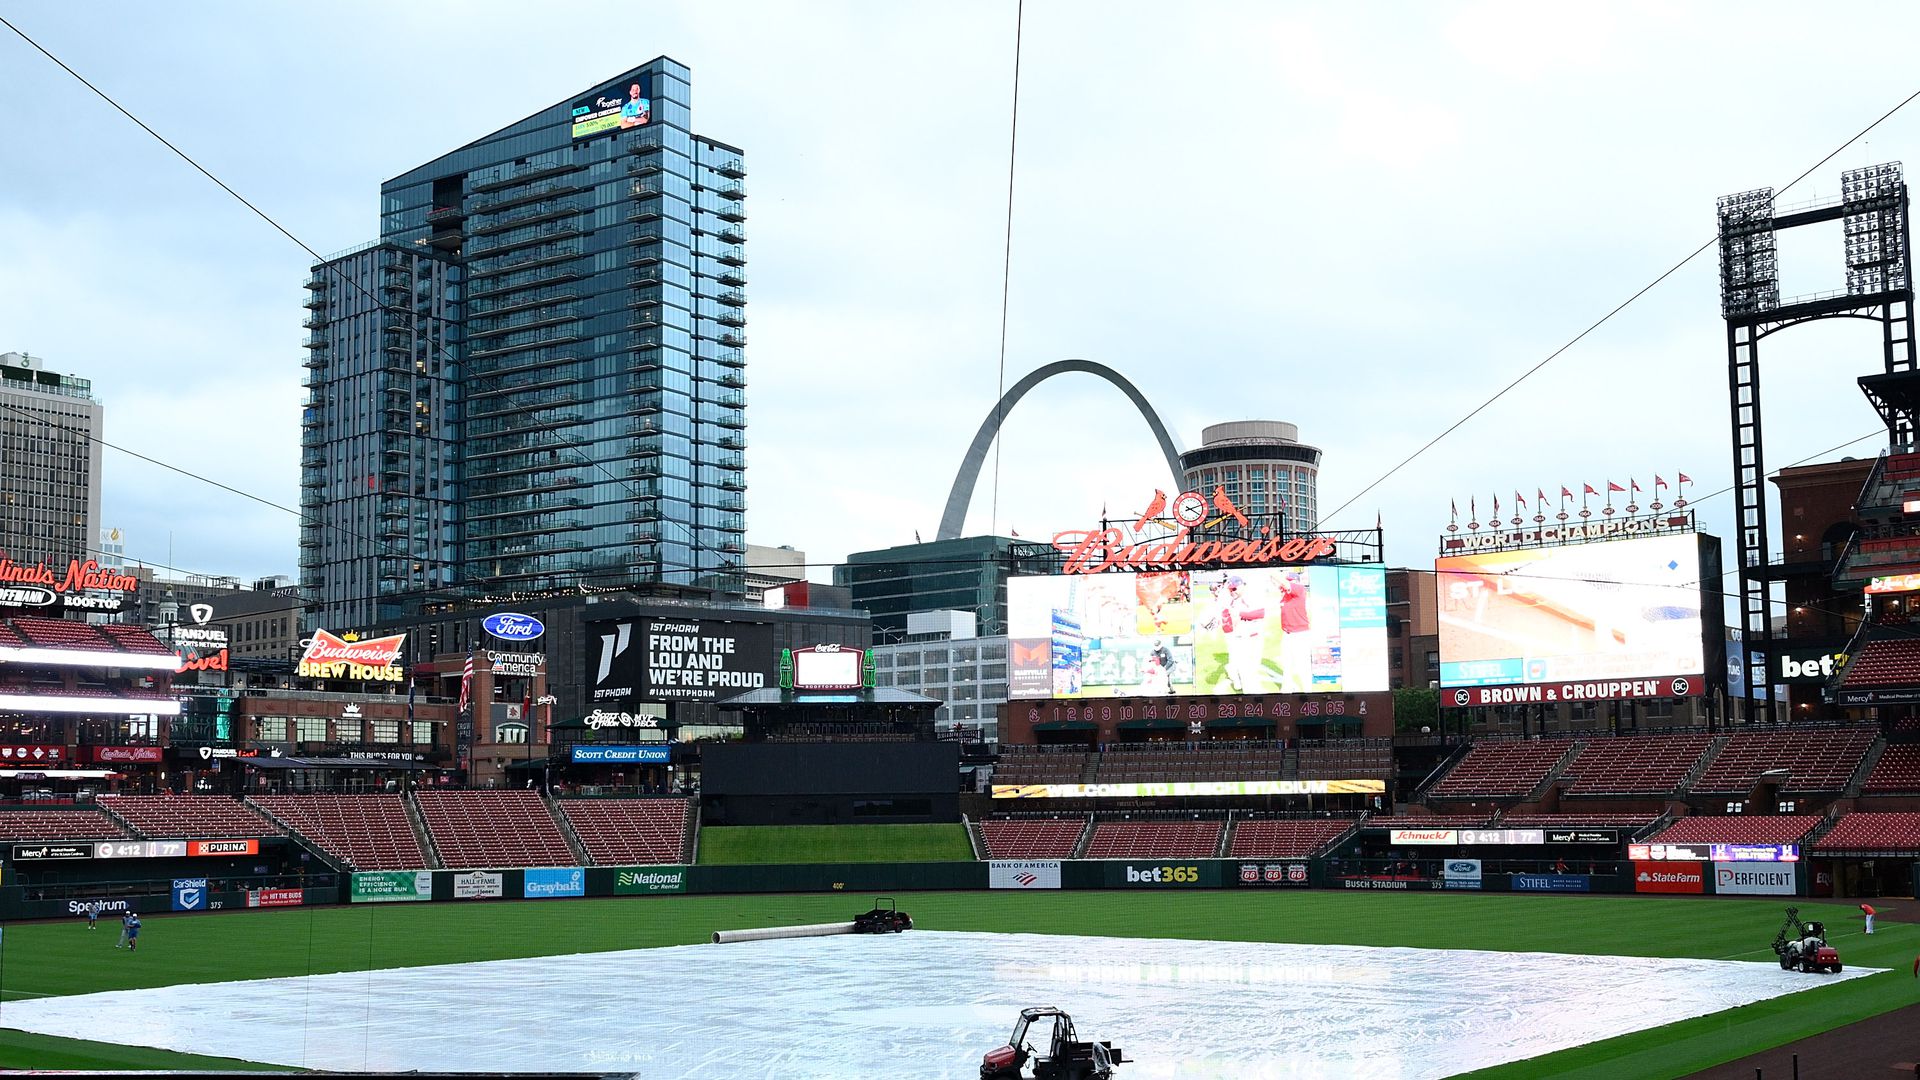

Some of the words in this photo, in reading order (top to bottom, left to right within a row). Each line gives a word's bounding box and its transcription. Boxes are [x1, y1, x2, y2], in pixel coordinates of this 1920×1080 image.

[601, 98, 622, 108] Together
[1463, 531, 1535, 549] WORLD
[1541, 517, 1669, 541] CHAMPIONS
[1053, 527, 1337, 574] Budweiser
[55, 560, 136, 592] Nation
[271, 589, 291, 598] HYATT
[64, 596, 121, 609] ROOFTOP
[496, 616, 533, 635] Ford
[175, 628, 228, 641] FANDUEL
[300, 639, 402, 661] Budweiser
[650, 635, 698, 652] FROM
[702, 638, 735, 653] THE
[488, 651, 544, 666] Community
[650, 652, 682, 668] LOU
[687, 654, 722, 670] AND
[492, 657, 536, 673] America
[299, 663, 346, 678] BREW
[350, 665, 403, 681] HOUSE
[649, 669, 704, 686] WE'RE
[708, 671, 764, 688] PROUD
[1481, 686, 1542, 704] BROWN
[1546, 689, 1557, 701] &
[1562, 680, 1658, 701] CROUPPEN
[1674, 682, 1686, 691] BC
[650, 689, 715, 697] #IAM1STPHORM
[1457, 693, 1467, 702] BC
[1847, 695, 1869, 703] Mercy
[1054, 708, 1059, 720] 1
[1067, 708, 1076, 721] 2
[1084, 707, 1093, 720] 6
[1102, 707, 1111, 720] 9
[1120, 706, 1133, 719] 10
[1143, 706, 1157, 719] 14
[1166, 705, 1180, 718] 17
[1189, 704, 1207, 718] 20
[1219, 704, 1236, 717] 23
[1245, 703, 1263, 717] 24
[1272, 702, 1290, 716] 42
[1300, 702, 1319, 716] 45
[1326, 701, 1344, 715] 85
[574, 750, 603, 759] SCOTT
[604, 750, 637, 758] CREDIT
[638, 750, 667, 758] UNION
[1479, 832, 1500, 841] 4:12
[1553, 833, 1571, 842] Mercy
[22, 849, 42, 858] Mercy
[117, 845, 140, 855] 4:12
[210, 843, 246, 852] PURINA
[1453, 862, 1471, 872] Ford
[633, 872, 682, 884] National
[1126, 866, 1198, 882] bet365
[1718, 869, 1791, 886] PERFICIENT
[173, 879, 206, 889] CarShield
[1345, 880, 1370, 888] BUSCH
[1372, 881, 1407, 889] STADIUM
[1520, 877, 1551, 888] STIFEL
[210, 901, 222, 909] 375'
